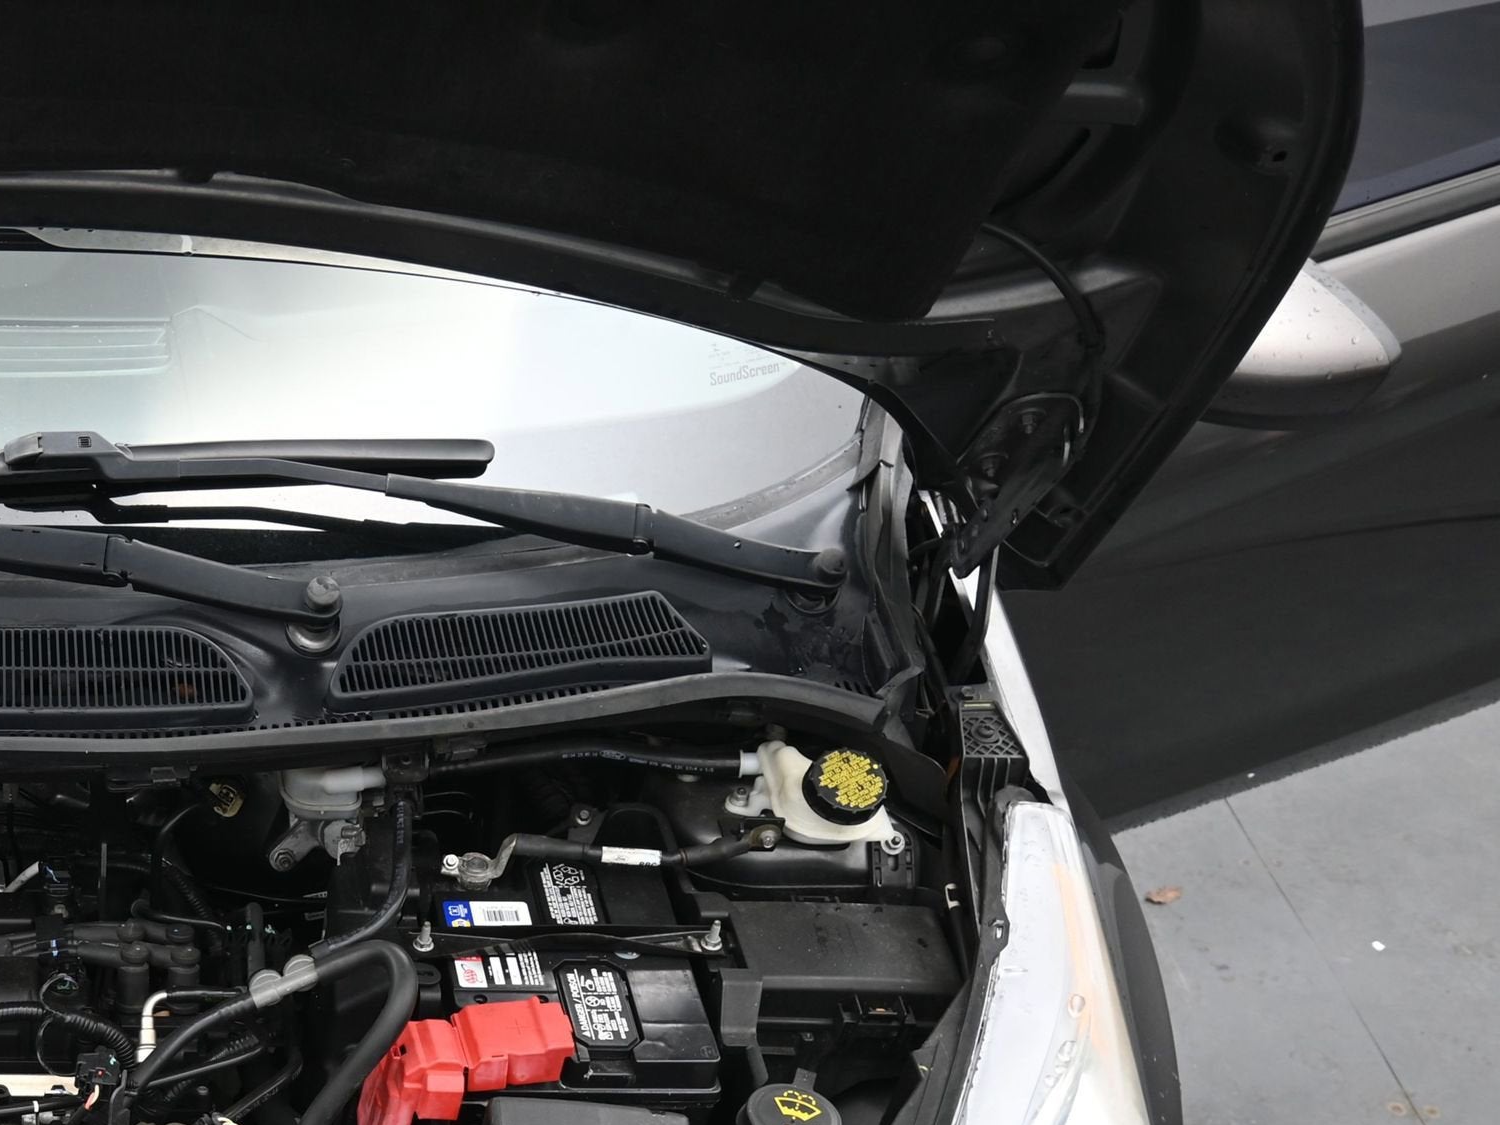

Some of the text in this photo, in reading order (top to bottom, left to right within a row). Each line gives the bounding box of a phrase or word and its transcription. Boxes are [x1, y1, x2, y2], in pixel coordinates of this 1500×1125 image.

[709, 362, 780, 386] SoundScreen
[566, 973, 580, 998] POISON
[574, 1002, 590, 1031] DANGER
